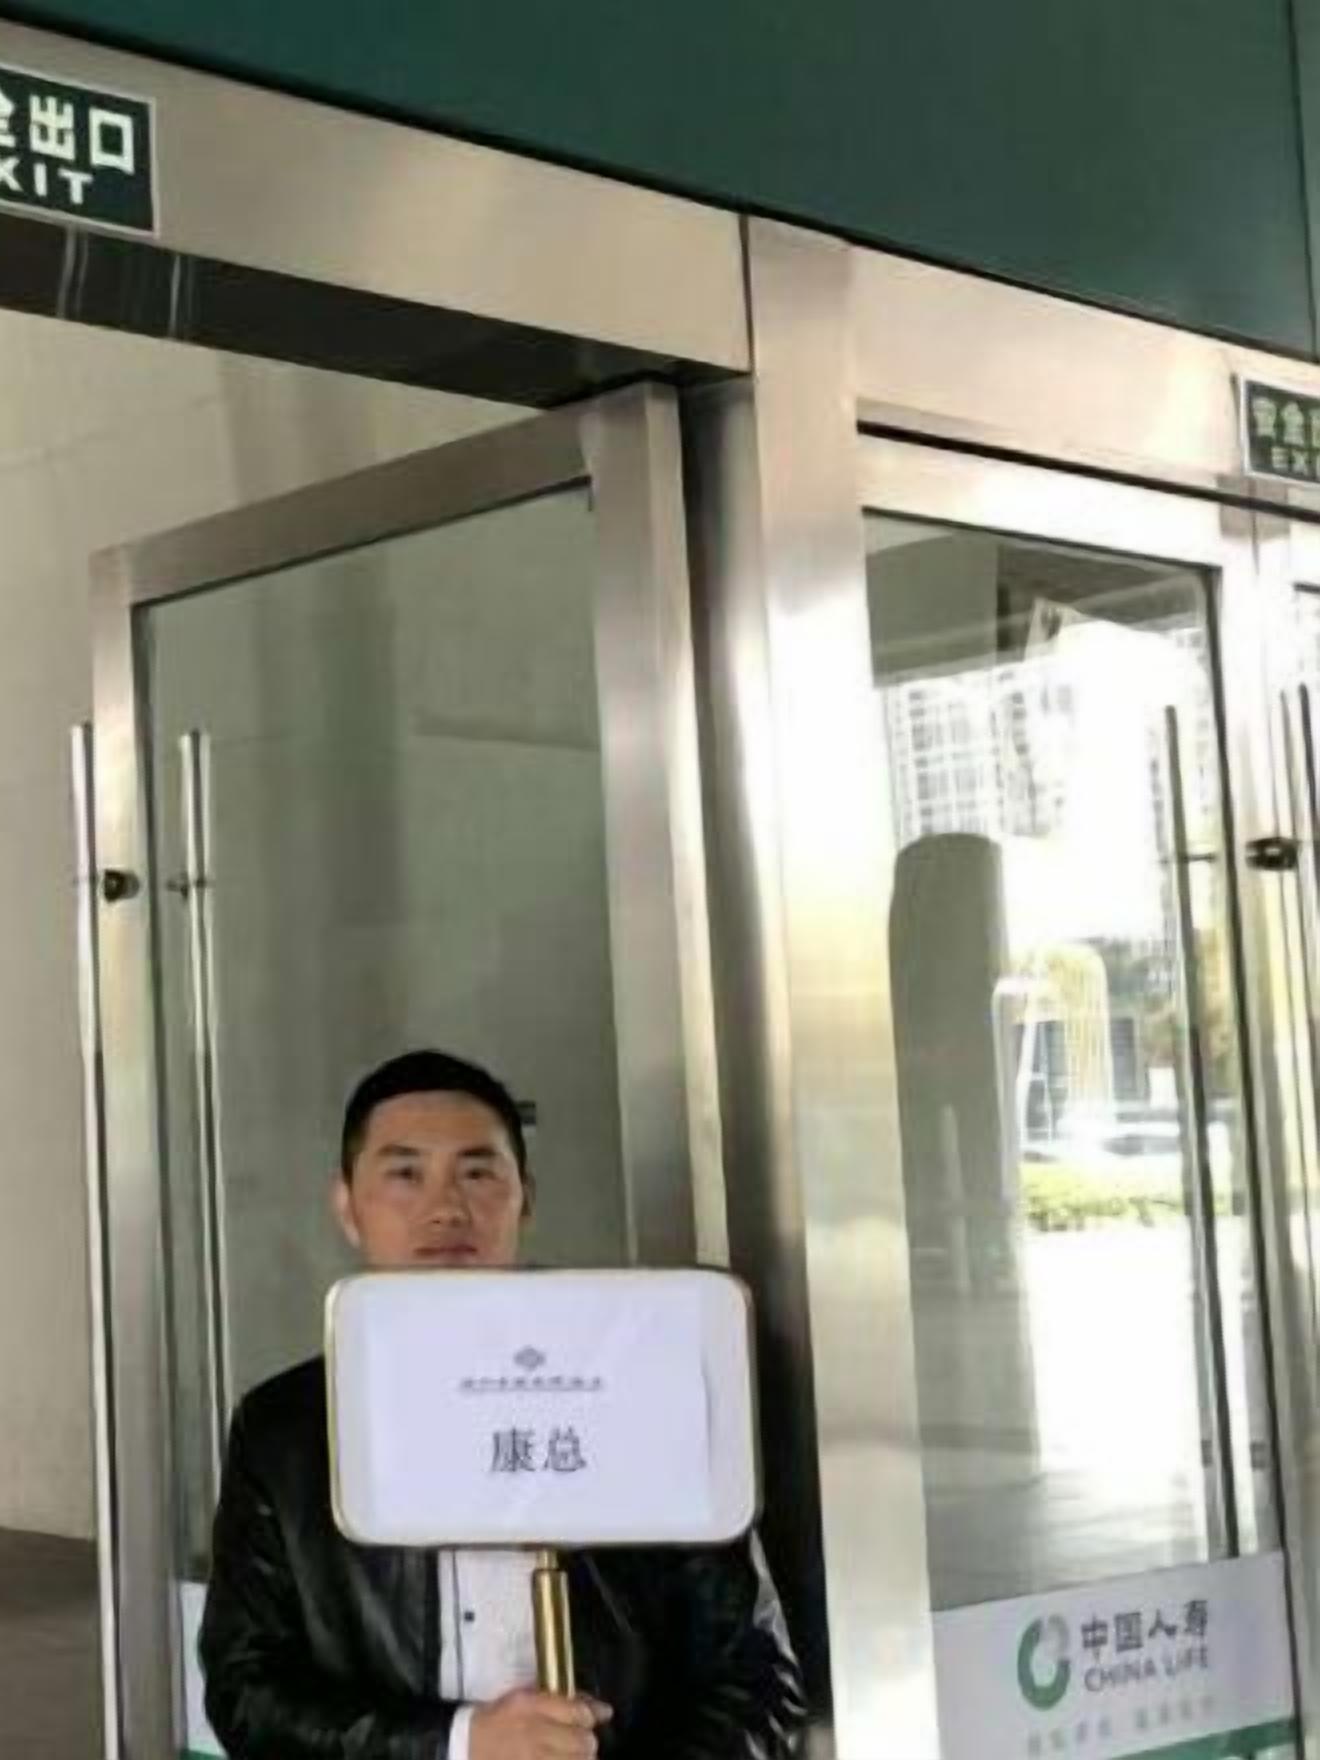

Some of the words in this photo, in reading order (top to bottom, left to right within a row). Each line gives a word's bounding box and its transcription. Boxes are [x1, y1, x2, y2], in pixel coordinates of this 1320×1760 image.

[489, 1427, 587, 1474] 康总
[1080, 1599, 1208, 1662] 中国人寿
